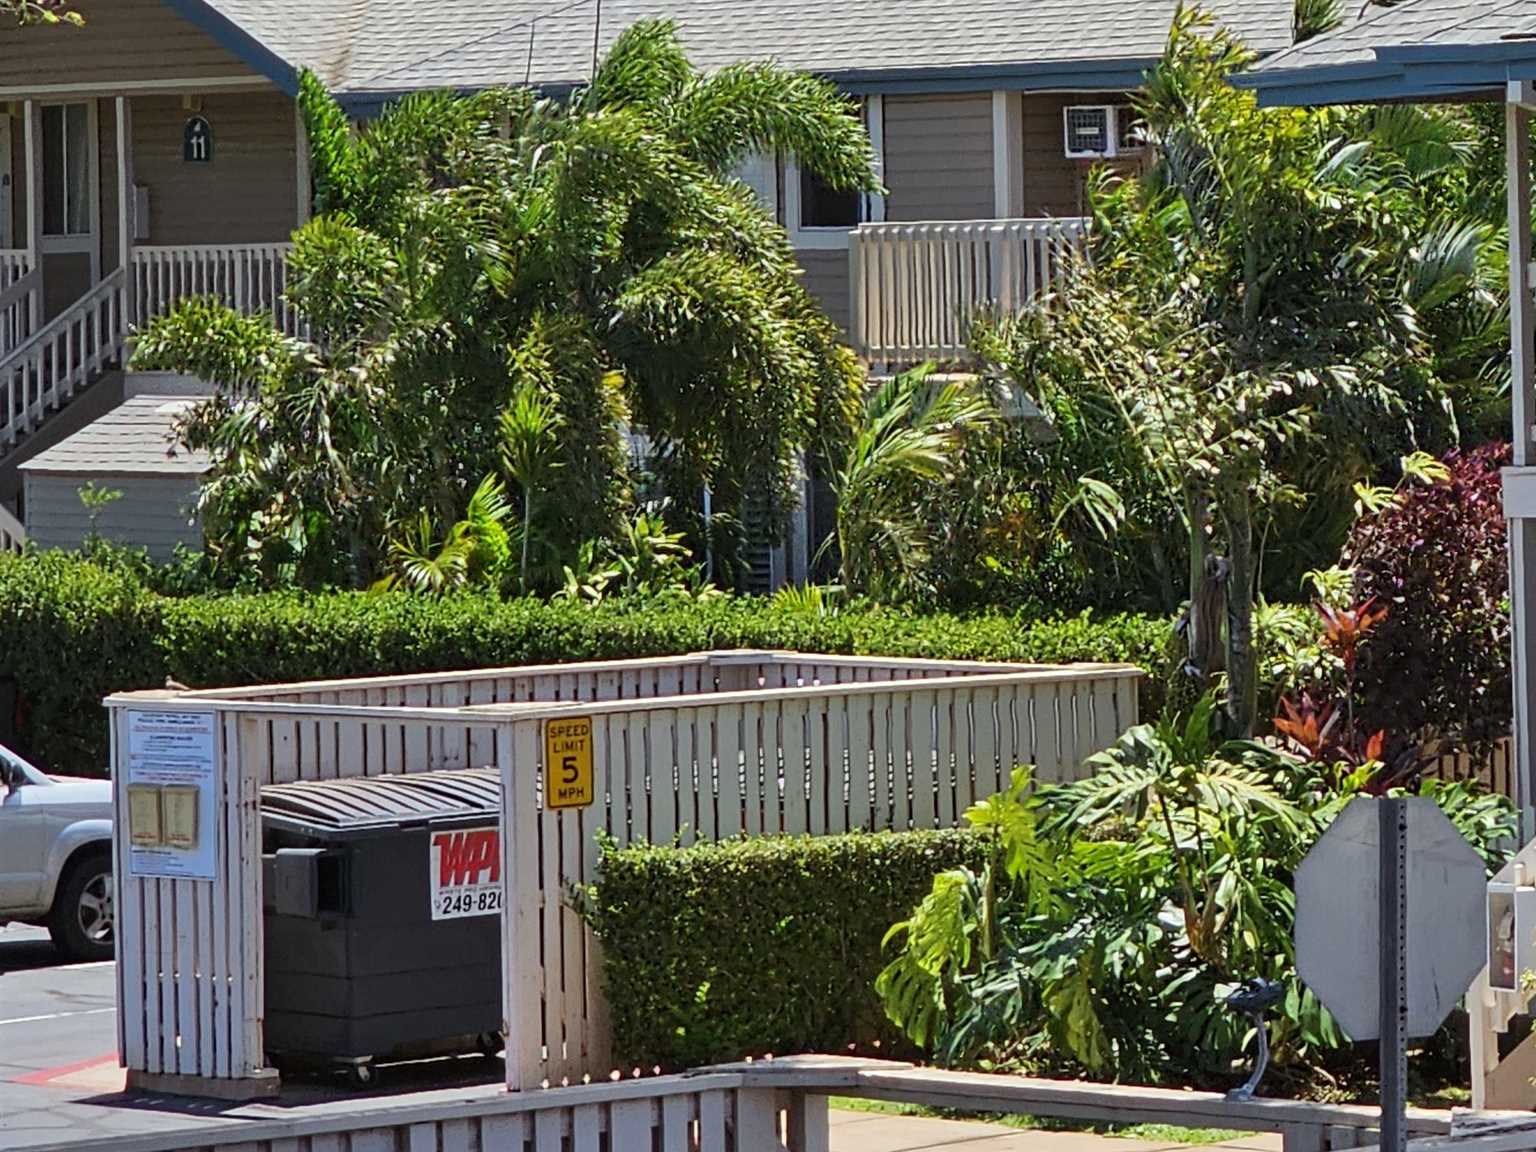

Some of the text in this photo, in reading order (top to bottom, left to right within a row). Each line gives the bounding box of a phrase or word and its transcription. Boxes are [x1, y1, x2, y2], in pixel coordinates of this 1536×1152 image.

[190, 135, 206, 160] 11
[550, 723, 589, 740] SPEED
[553, 739, 586, 754] LIMIT
[561, 757, 579, 784] 5
[557, 786, 585, 800] MPH
